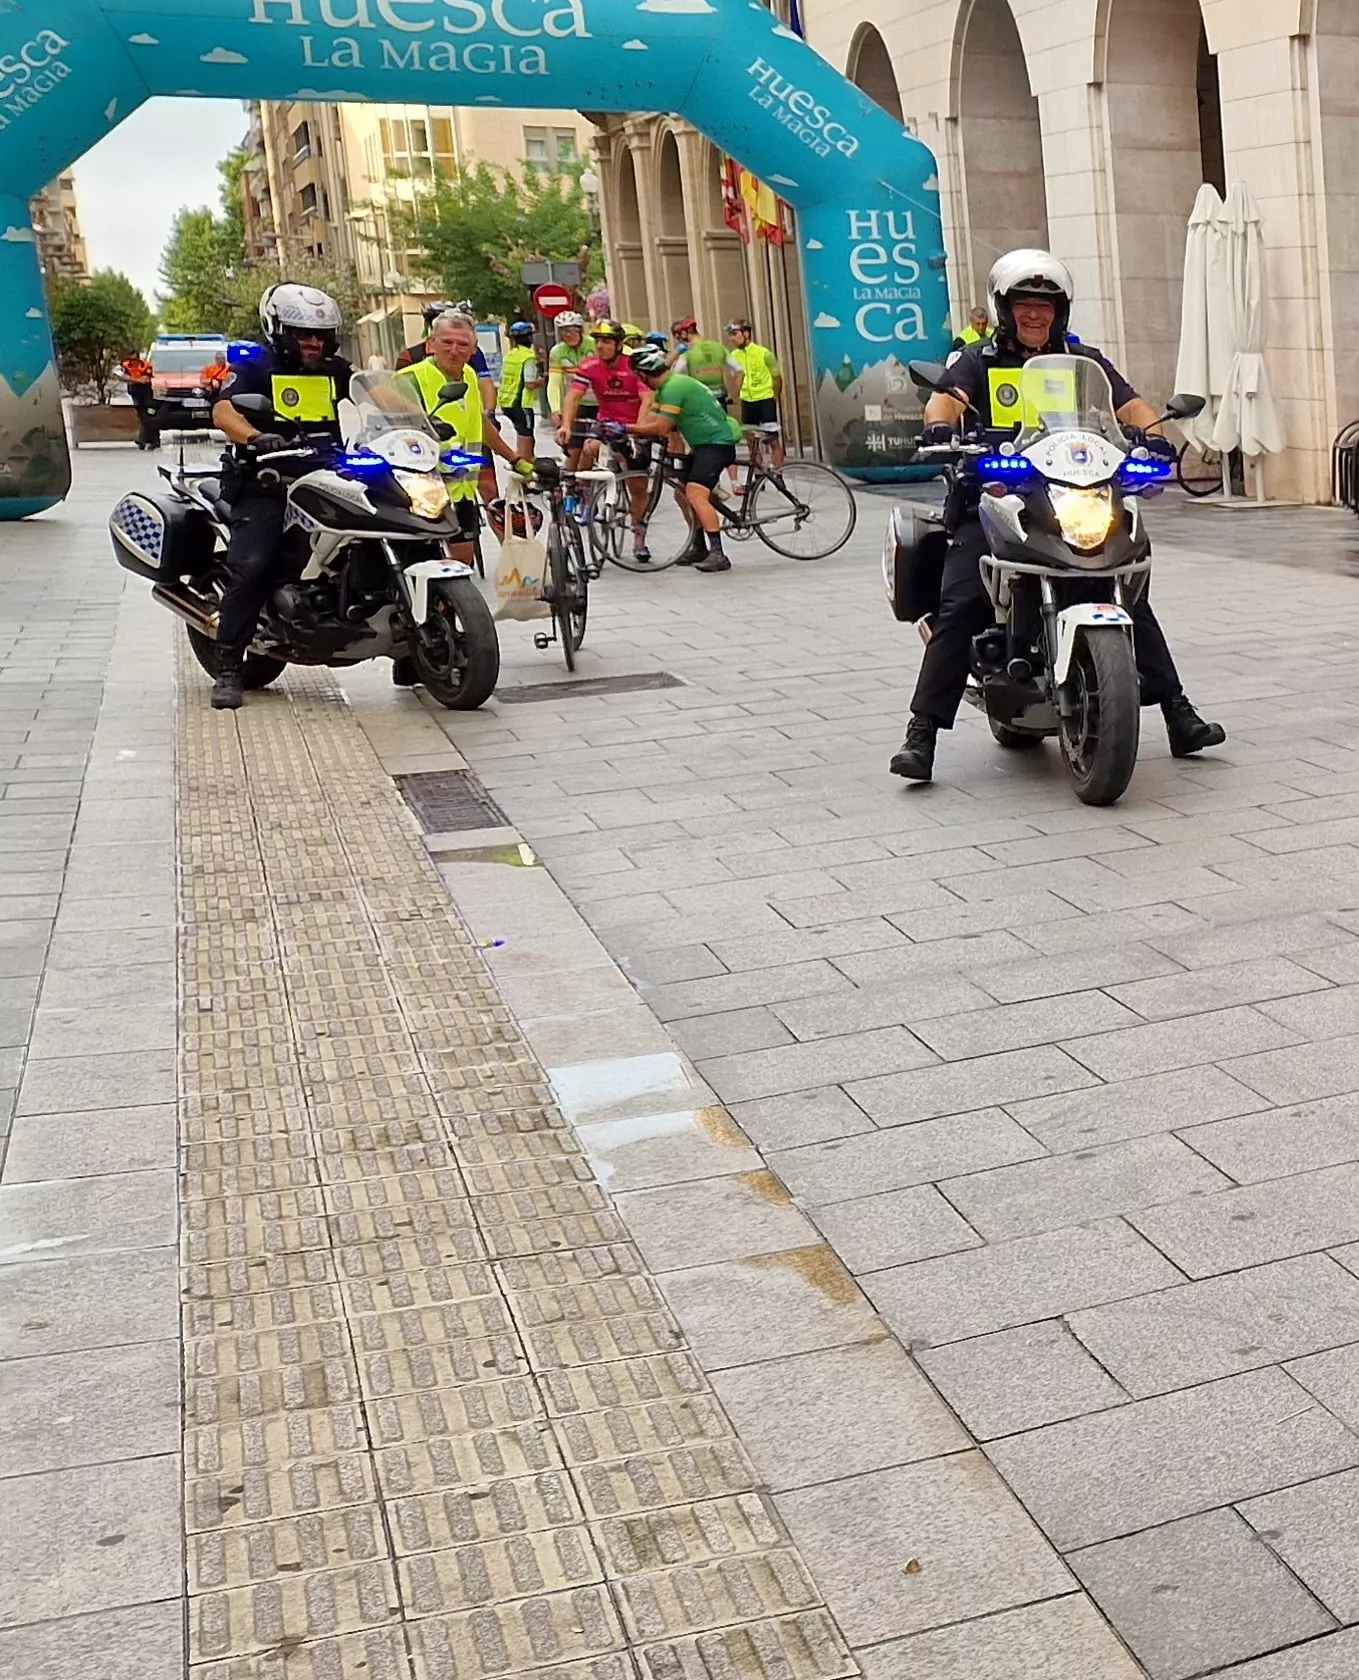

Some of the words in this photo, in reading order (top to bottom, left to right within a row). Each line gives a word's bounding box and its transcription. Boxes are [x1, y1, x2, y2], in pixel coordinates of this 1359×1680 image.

[300, 36, 365, 69] La
[745, 55, 860, 159] Huesca
[849, 242, 920, 284] es
